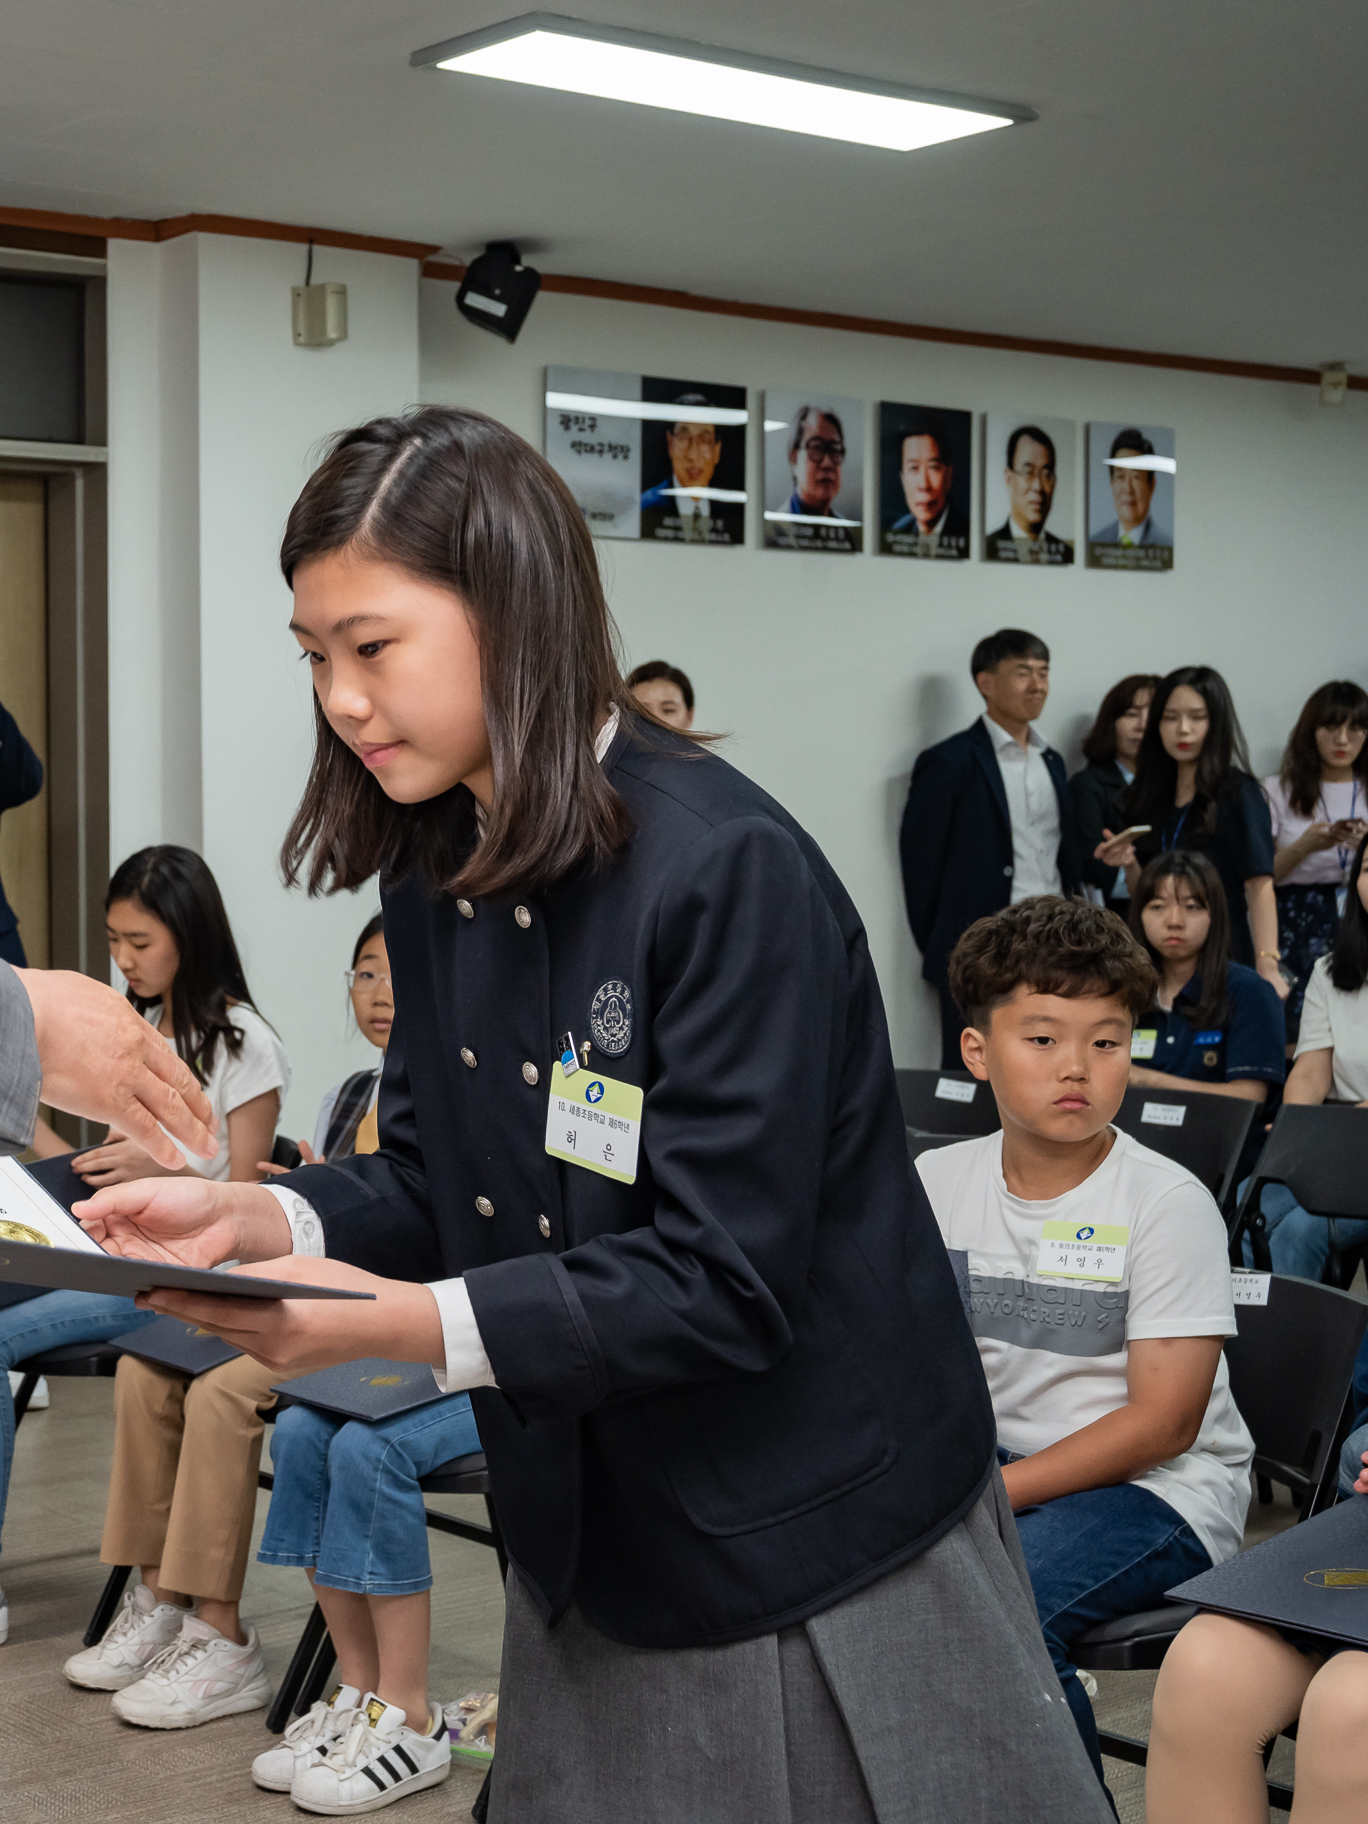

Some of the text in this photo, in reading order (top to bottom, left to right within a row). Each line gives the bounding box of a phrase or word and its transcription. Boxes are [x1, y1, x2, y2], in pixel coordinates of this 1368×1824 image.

[559, 413, 598, 433] 광진구
[568, 1104, 606, 1125] 세종초등학교
[607, 1116, 630, 1134] 제6학년
[566, 1130, 615, 1162] 허 은
[1056, 1254, 1105, 1270] 서 영 우
